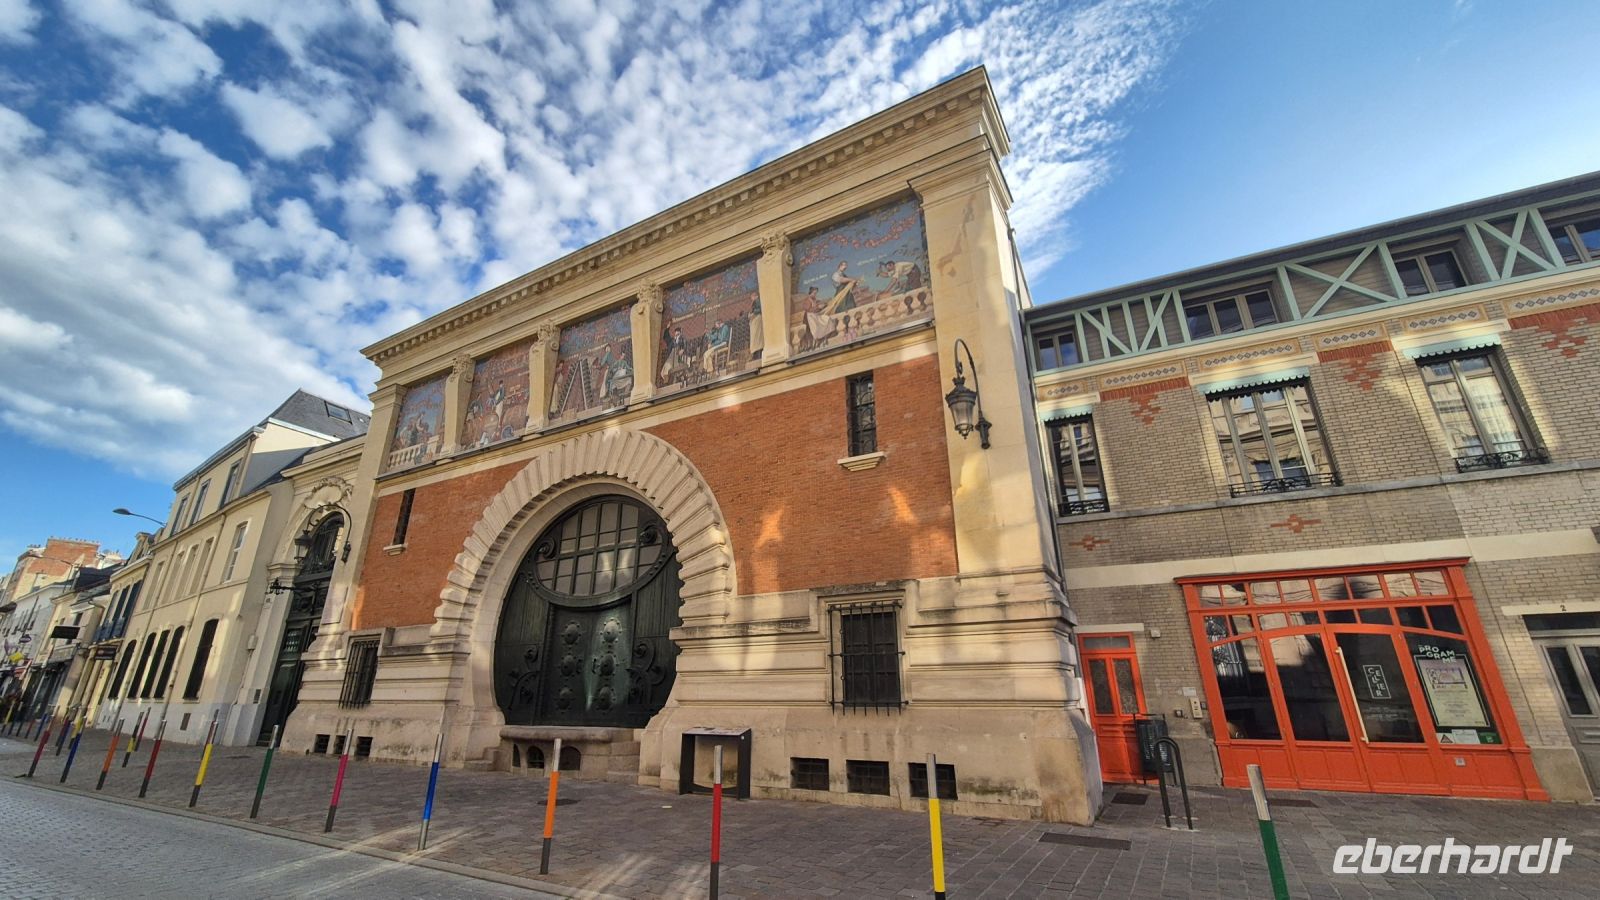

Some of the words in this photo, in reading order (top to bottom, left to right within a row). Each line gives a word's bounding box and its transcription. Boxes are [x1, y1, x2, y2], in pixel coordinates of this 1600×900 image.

[1560, 604, 1567, 612] 2
[1418, 645, 1440, 653] PRO
[1426, 650, 1455, 660] GRAM
[1442, 656, 1457, 664] ME
